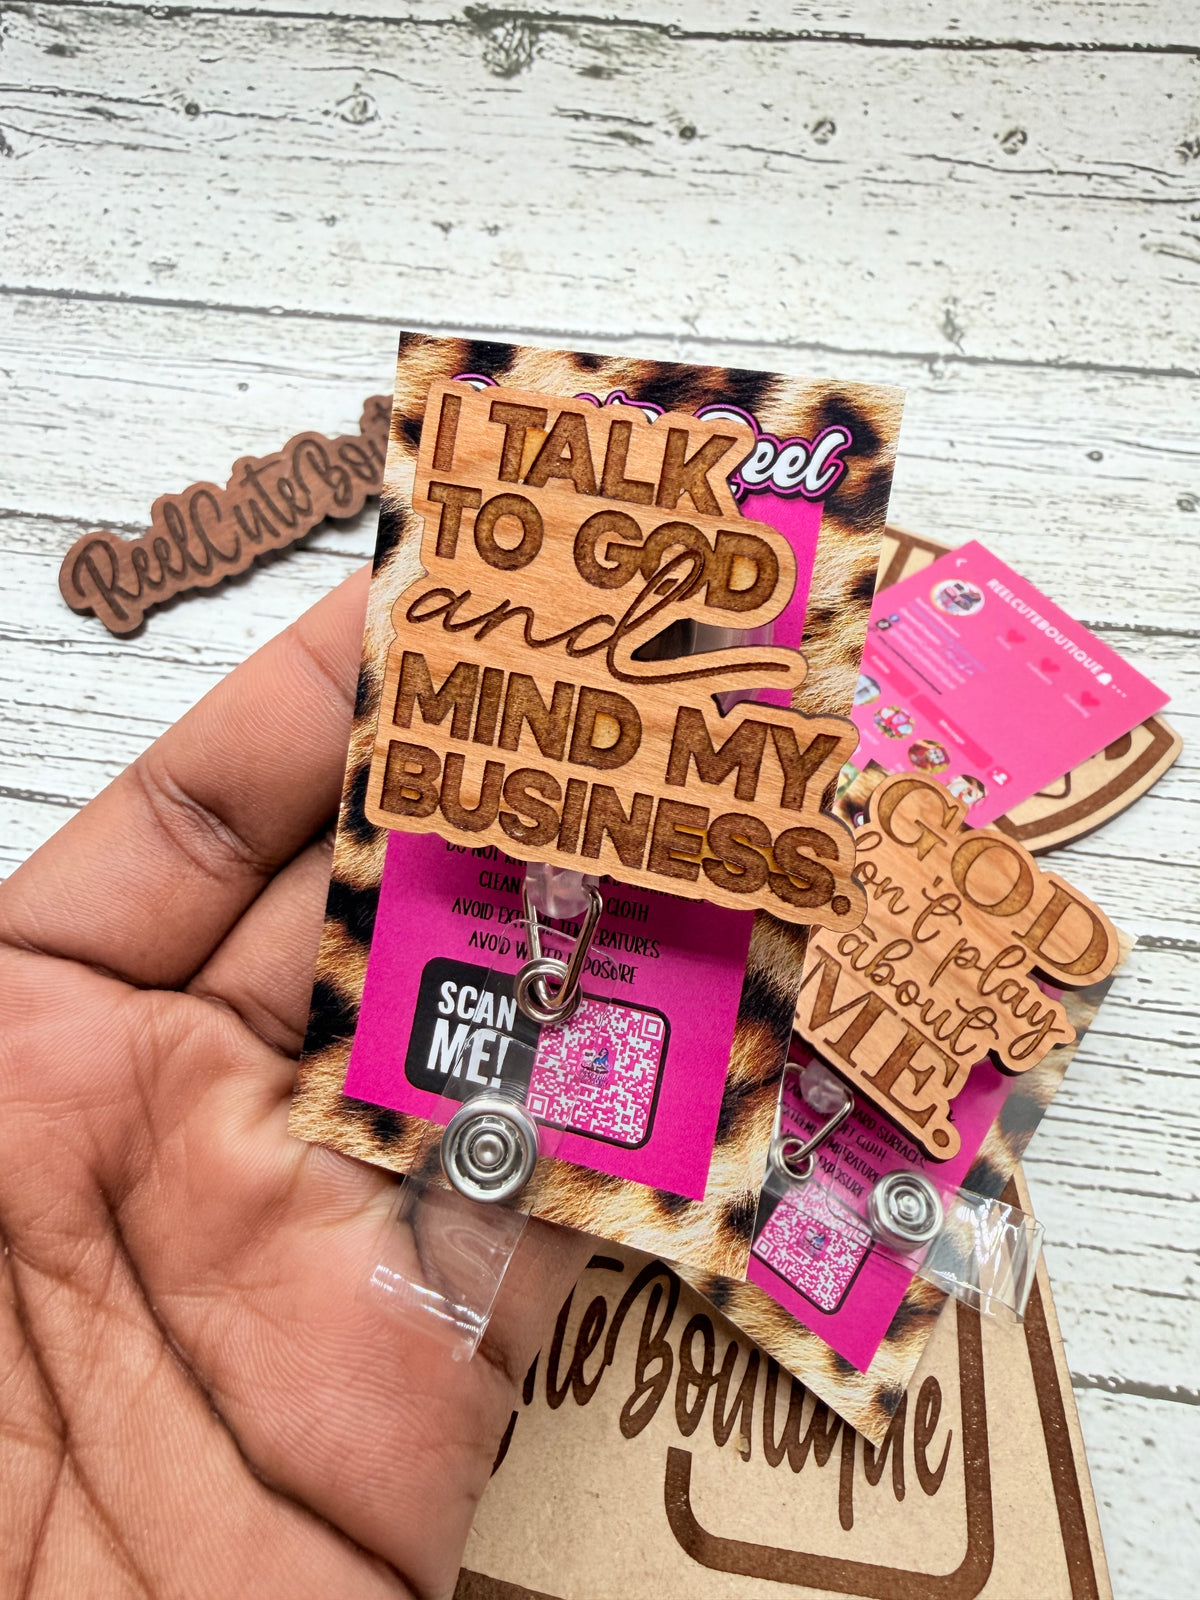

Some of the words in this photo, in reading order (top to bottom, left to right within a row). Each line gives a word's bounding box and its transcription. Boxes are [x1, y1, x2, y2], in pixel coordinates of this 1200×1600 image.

[72, 402, 390, 621] ReelCuteBo
[431, 393, 460, 472] I
[489, 400, 741, 516] TALK
[735, 424, 852, 498] eel
[427, 481, 544, 570] TO
[573, 510, 780, 612] GOD
[405, 550, 790, 685] and
[392, 650, 643, 770] MIND
[664, 706, 841, 812] MY
[379, 739, 852, 916] BUSINESS.
[877, 778, 1109, 977] GOD
[451, 897, 494, 921] AVOID
[560, 918, 661, 959] TEMERATURES
[468, 930, 511, 955] AVOID
[515, 940, 563, 963] WTER
[566, 952, 639, 985] POSURE
[478, 870, 521, 895] CLEAN
[605, 897, 649, 923] CLOTH
[852, 830, 963, 943] on't
[929, 937, 1066, 1061] play
[426, 1017, 512, 1088] ME!
[437, 981, 518, 1032] SCAN
[836, 933, 1000, 1056] about
